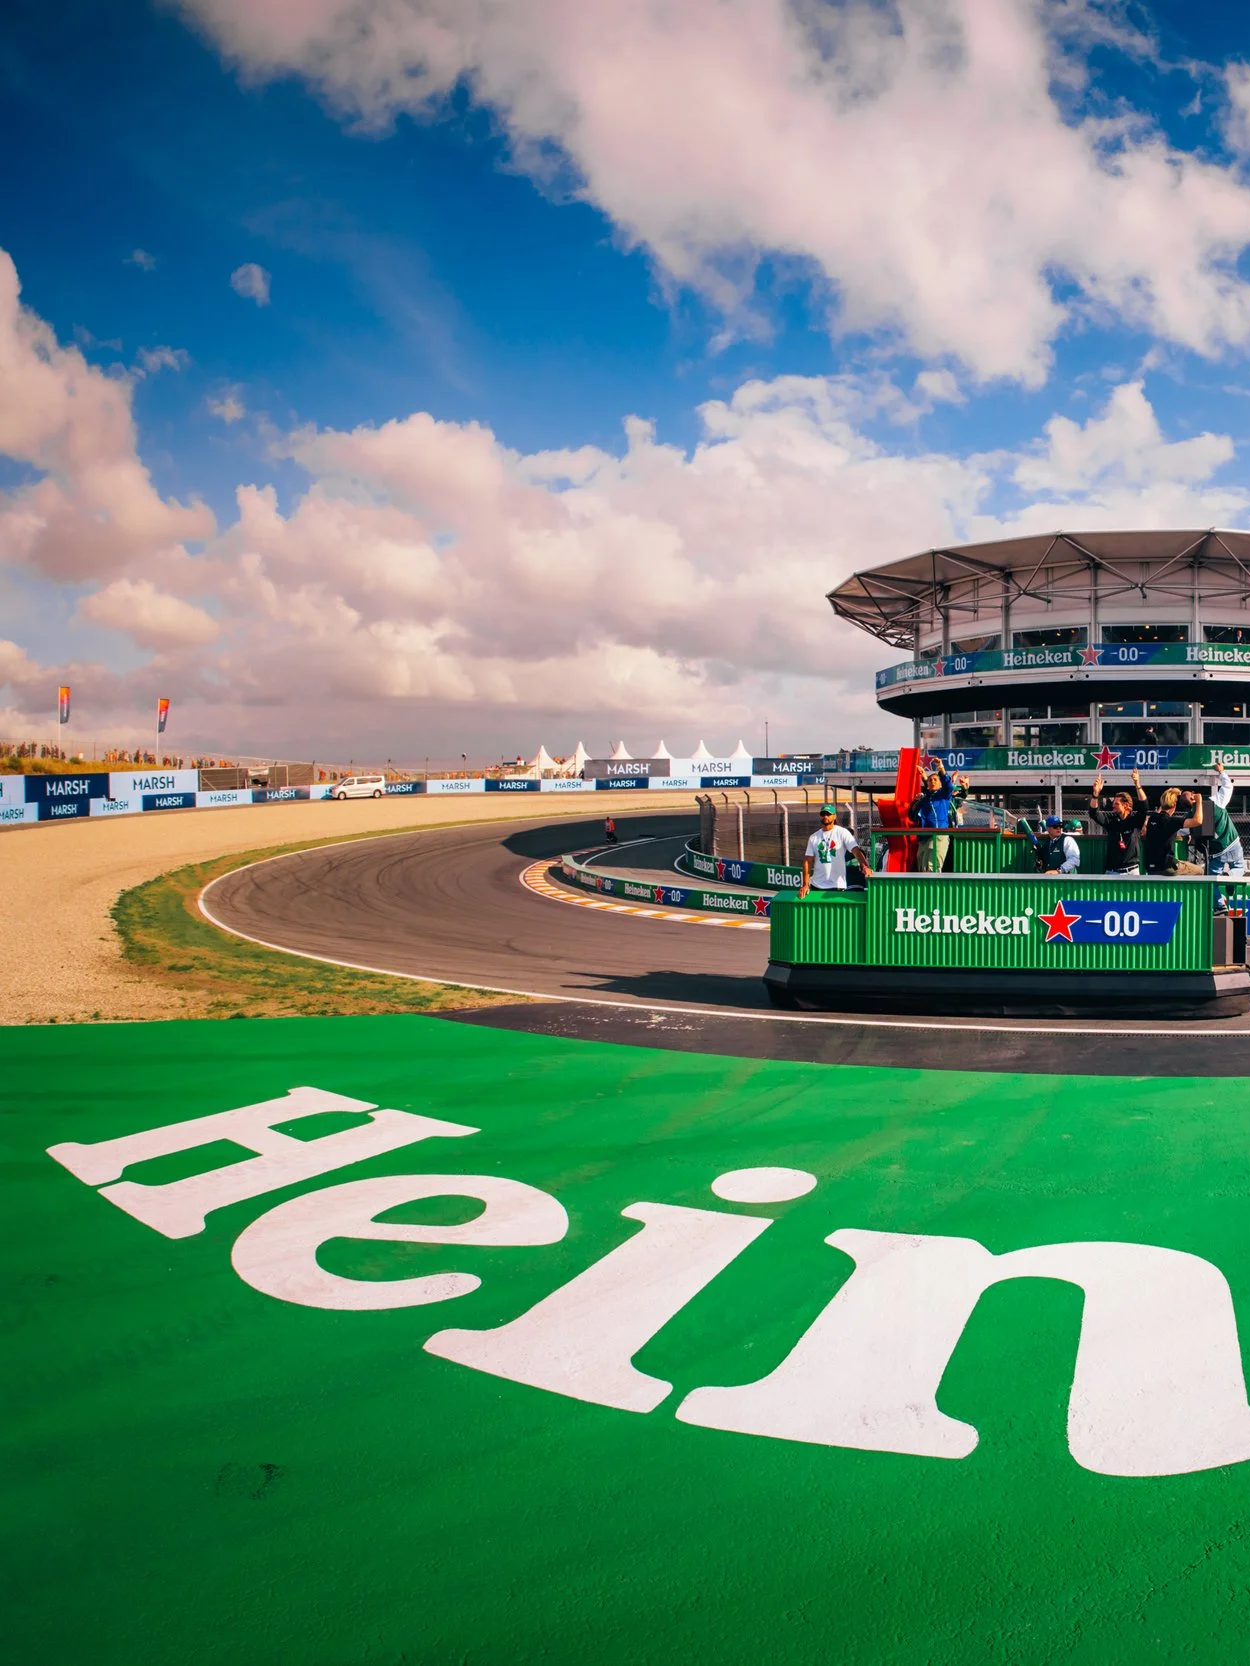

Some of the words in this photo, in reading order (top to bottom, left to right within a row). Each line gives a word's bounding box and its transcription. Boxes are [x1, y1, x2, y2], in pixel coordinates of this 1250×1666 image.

[1003, 650, 1073, 667] Heineken
[1118, 648, 1139, 661] 0.0
[607, 763, 650, 774] MARSH
[691, 762, 732, 773] MARSH
[772, 762, 812, 772] MARSH
[871, 755, 899, 769] Heine
[947, 753, 965, 767] 0.0
[1007, 750, 1086, 766] Heineken
[1136, 750, 1158, 766] 0.0
[46, 780, 90, 796] MARSH
[133, 776, 175, 791] MARSH
[51, 804, 77, 815] MARSH
[103, 801, 129, 811] MARSH
[155, 797, 183, 806] MARSH
[209, 794, 237, 802] MARSH
[266, 790, 296, 799] MARSH
[441, 782, 470, 790] MARSH
[499, 782, 528, 790] MARSH
[609, 779, 636, 787] MARSH
[662, 778, 688, 786] MARSH
[767, 868, 803, 888] Heine
[702, 894, 750, 910] Heineken
[895, 908, 1031, 935] Heineken
[1103, 911, 1140, 937] 0.0
